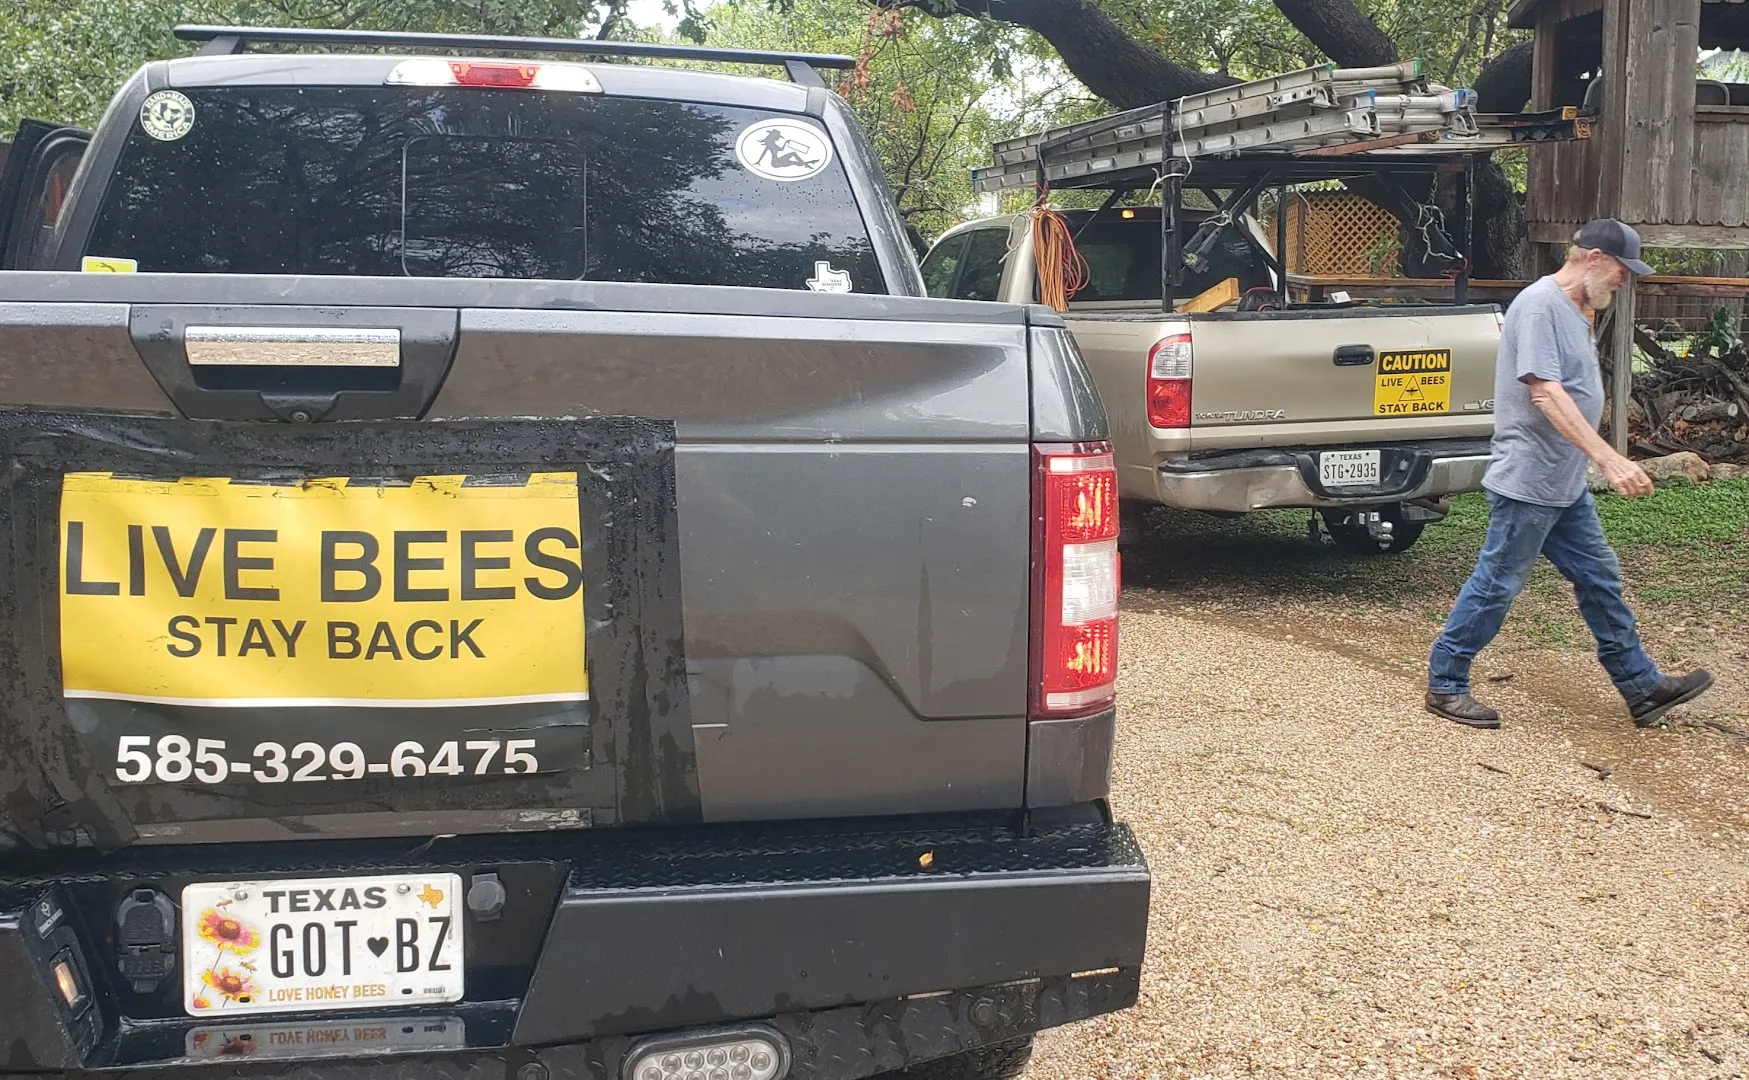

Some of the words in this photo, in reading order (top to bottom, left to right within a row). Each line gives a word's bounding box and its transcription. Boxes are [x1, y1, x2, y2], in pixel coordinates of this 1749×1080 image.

[143, 120, 191, 139] AMERICA
[1382, 353, 1447, 371] CAUTION
[1381, 377, 1403, 387] LIVE
[1421, 376, 1445, 385] BEES
[1223, 409, 1285, 421] TUNDRA
[1379, 403, 1408, 413] STAY
[1412, 401, 1444, 412] BACK
[65, 521, 280, 602] LIVE
[320, 527, 583, 602] BEES
[166, 615, 307, 659] STAY
[327, 618, 487, 661] BACK
[115, 734, 539, 784] 585-329-6475
[262, 886, 387, 913] TEXAS
[270, 920, 358, 979] GOT
[396, 916, 451, 973] BZ
[269, 988, 302, 1002] LOVE
[306, 984, 349, 1000] HONEY
[352, 984, 386, 997] BEES
